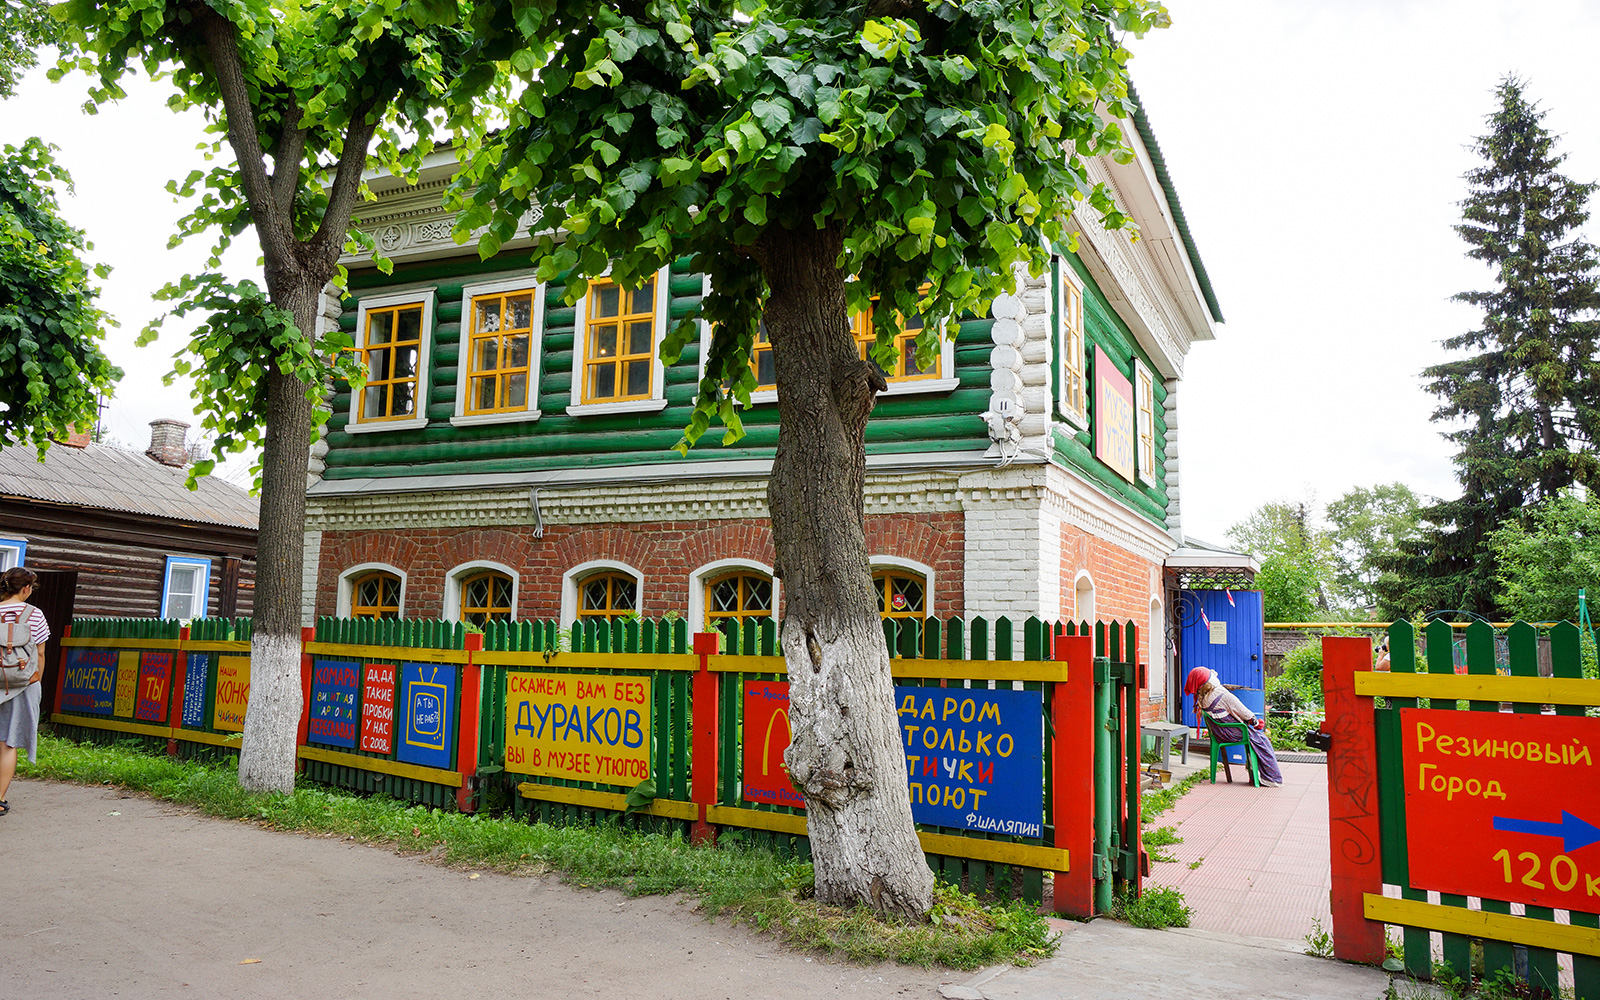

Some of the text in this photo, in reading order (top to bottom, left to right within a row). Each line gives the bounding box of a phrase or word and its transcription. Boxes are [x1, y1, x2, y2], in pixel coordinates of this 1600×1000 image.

[146, 654, 169, 666] БРОСАЙ
[64, 667, 114, 693] МОНЕТЫ
[118, 669, 136, 682] СКОРО
[220, 666, 237, 677] НАШИ
[315, 667, 360, 688] КОМАРЫ
[117, 684, 134, 698] SOCHI
[146, 677, 164, 701] ТЫ
[217, 680, 250, 705] КОНК
[317, 691, 354, 705] ВИЗИТНАЯ
[366, 686, 392, 702] ТАКИЕ
[510, 675, 645, 705] СКАЖЕМ ВАМ БЕЗ
[763, 687, 790, 701] Яросл
[141, 698, 161, 711] НУЖЕН
[416, 697, 434, 708] А ТЫ
[897, 695, 1002, 726] ДАРОМ
[136, 707, 160, 720] РОССИИ
[316, 705, 353, 720] КАРТОЧКА
[363, 703, 393, 721] ПРОБКИ
[416, 714, 424, 725] НЕ
[310, 717, 355, 741] ПЕРЕСЛАВЛЯ
[366, 719, 389, 735] У НАС
[514, 700, 644, 749] ДУРАКОВ
[362, 735, 367, 748] С
[904, 725, 1014, 758] ТОЛЬКО
[1416, 721, 1593, 766] Резиновый
[507, 745, 649, 780] ВЫ В МУЗЕЕ УТЮГОВ
[907, 755, 994, 784] ТИЧКИ
[1419, 763, 1507, 801] Город
[909, 782, 988, 811] ПОЮТ
